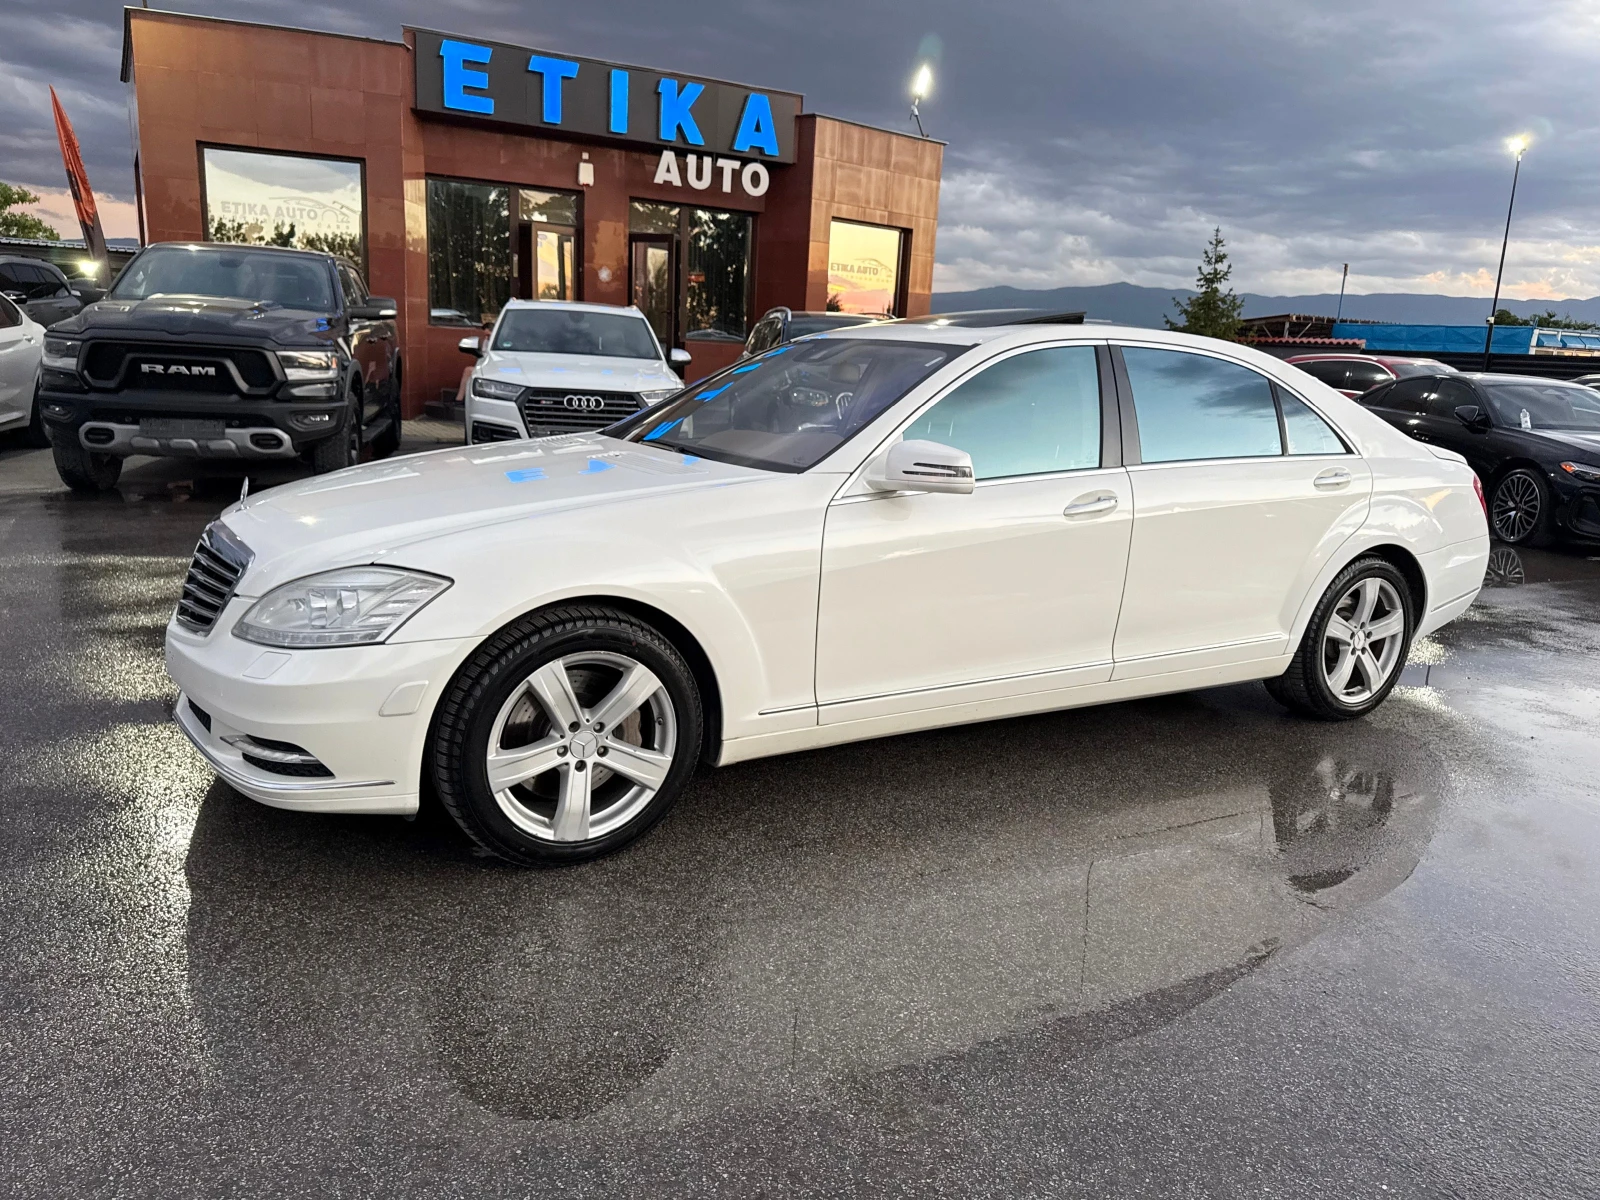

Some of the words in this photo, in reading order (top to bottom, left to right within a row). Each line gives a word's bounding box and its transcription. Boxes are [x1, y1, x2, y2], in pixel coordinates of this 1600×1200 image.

[439, 39, 780, 157] ETIKA
[653, 149, 770, 198] AUTO
[220, 200, 271, 217] ETIKA
[274, 206, 318, 221] AUTO
[830, 262, 855, 274] ETIKA
[856, 265, 879, 276] AUTO
[140, 363, 216, 376] RAM
